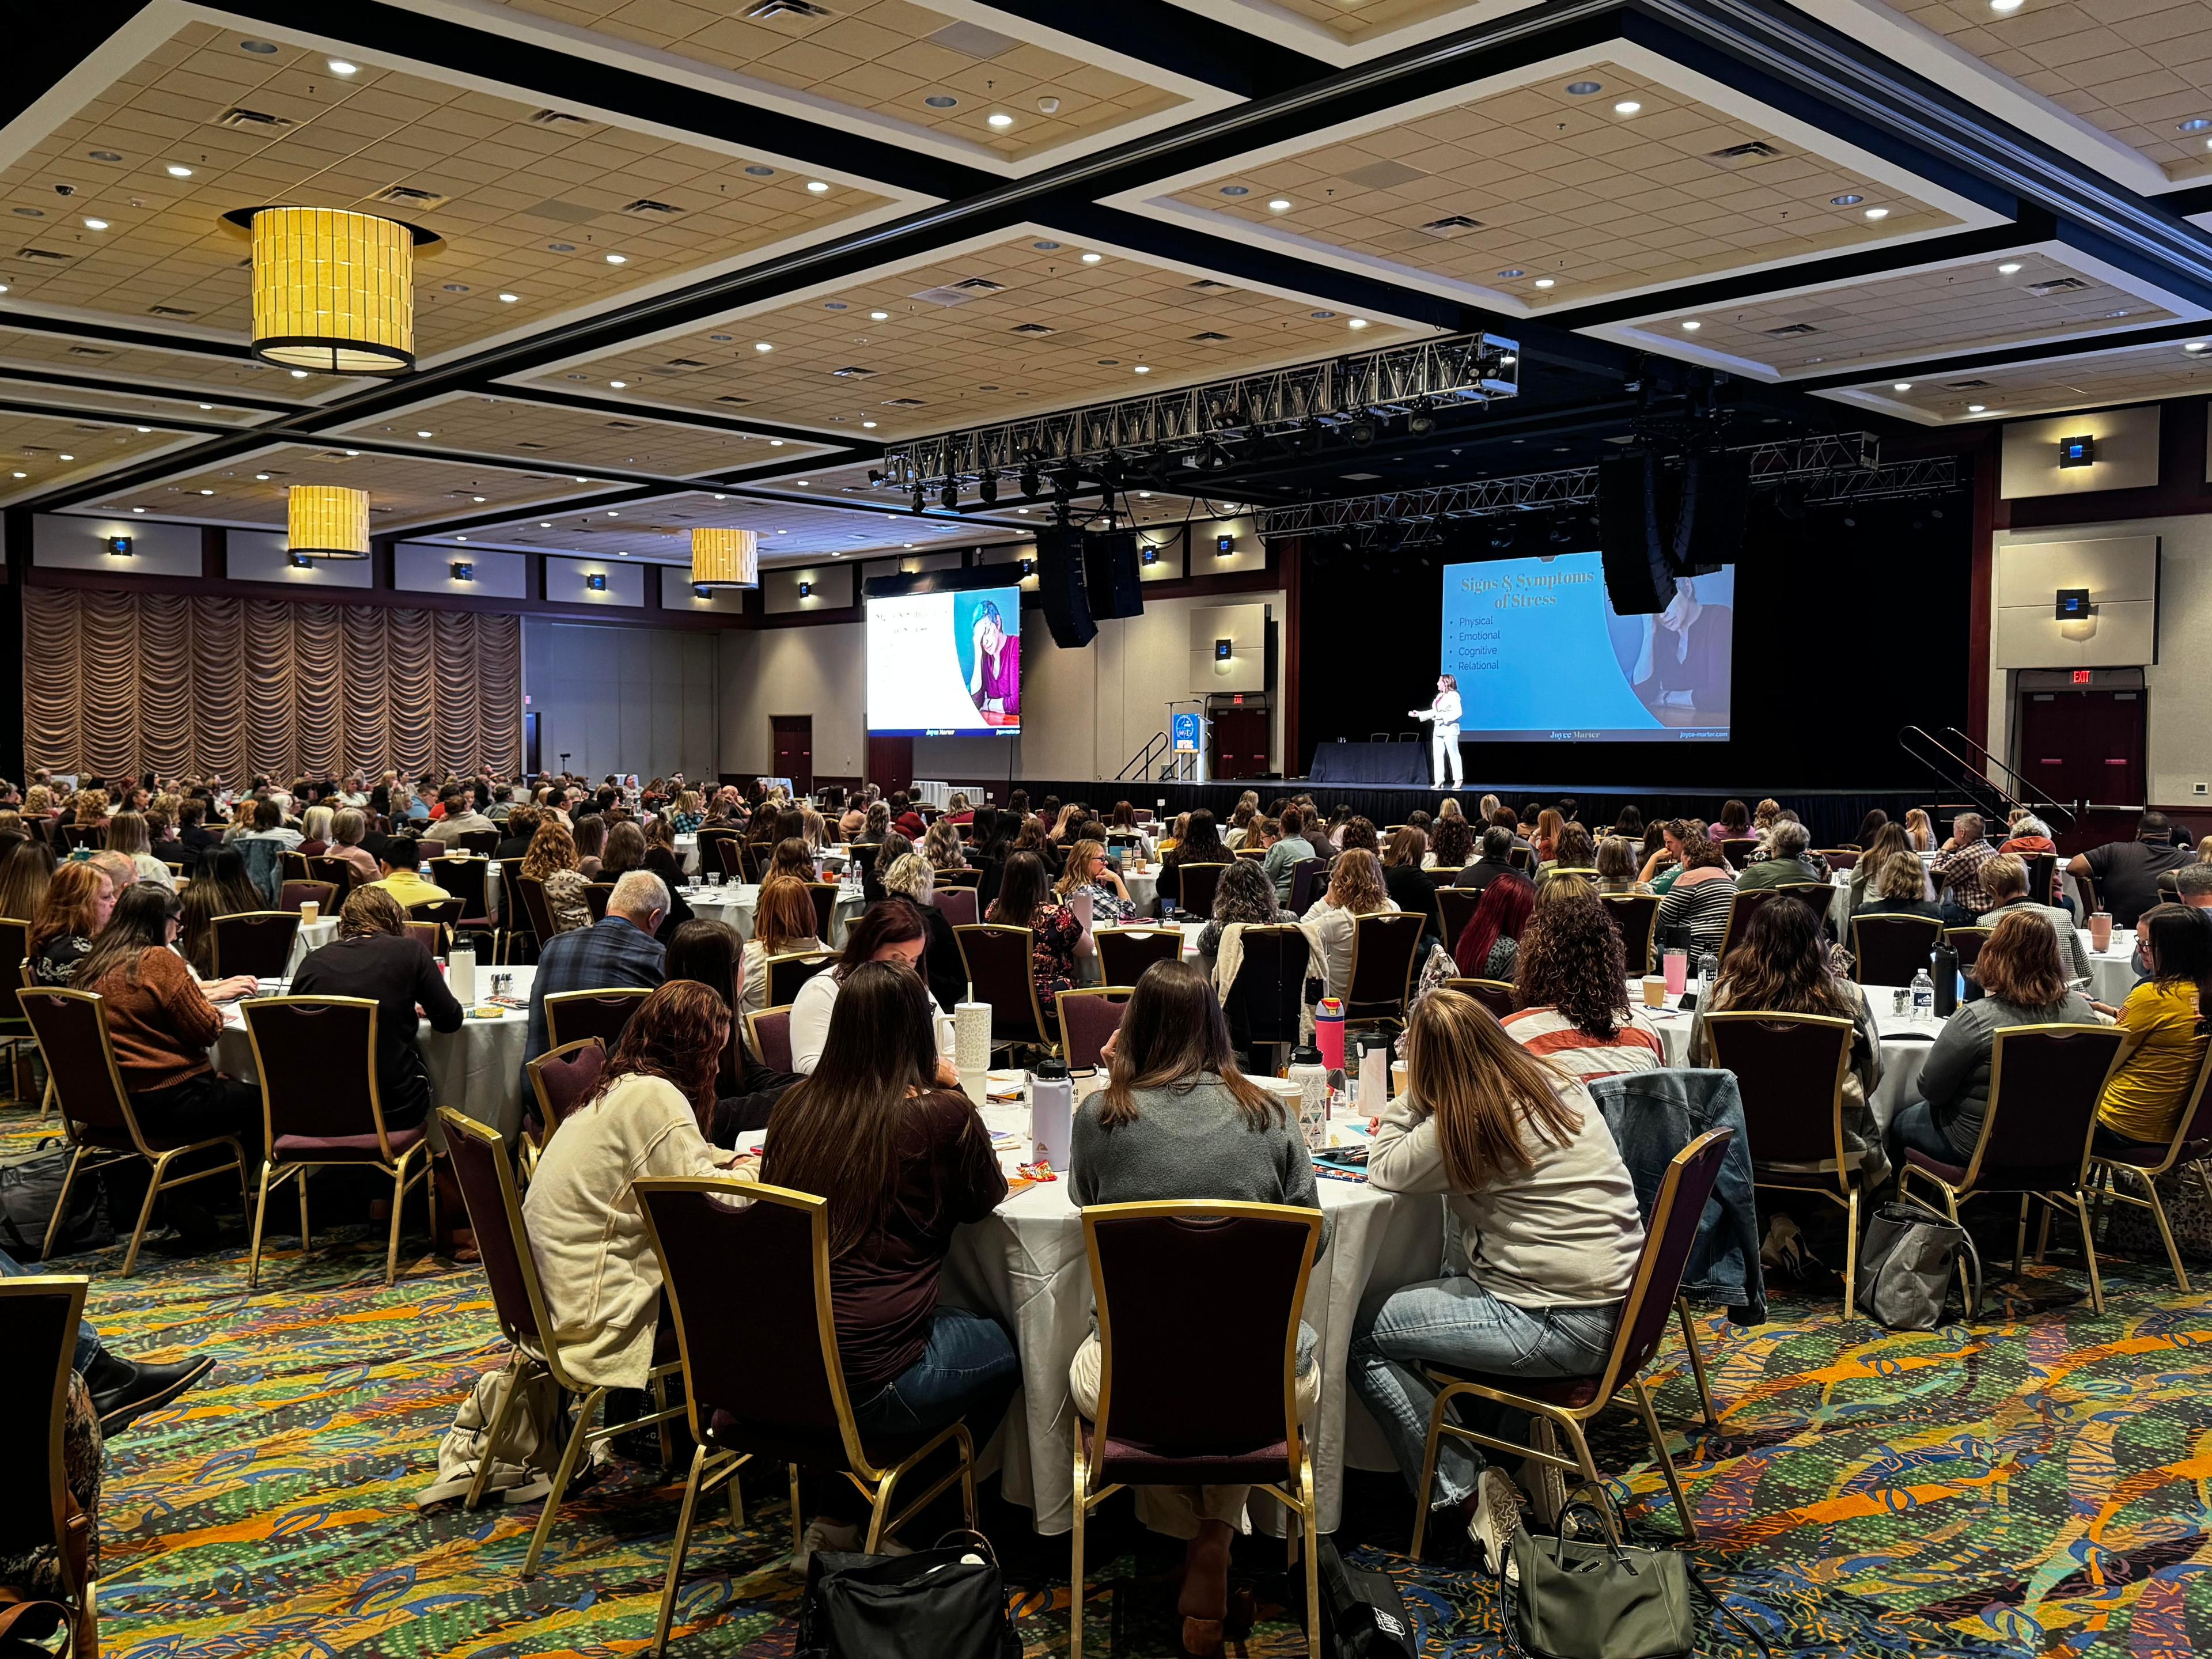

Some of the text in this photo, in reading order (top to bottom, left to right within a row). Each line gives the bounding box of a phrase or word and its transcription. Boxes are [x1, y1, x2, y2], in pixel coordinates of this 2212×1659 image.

[1461, 571, 1594, 595] Signs & Symptoms
[1494, 593, 1556, 609] of Stress
[1459, 615, 1493, 628] Physical
[1459, 630, 1501, 641] Emotional
[1459, 645, 1498, 658] Cognitive
[1459, 660, 1499, 671] Relational
[2073, 671, 2090, 683] EXIT
[1550, 731, 1572, 740] Joyce
